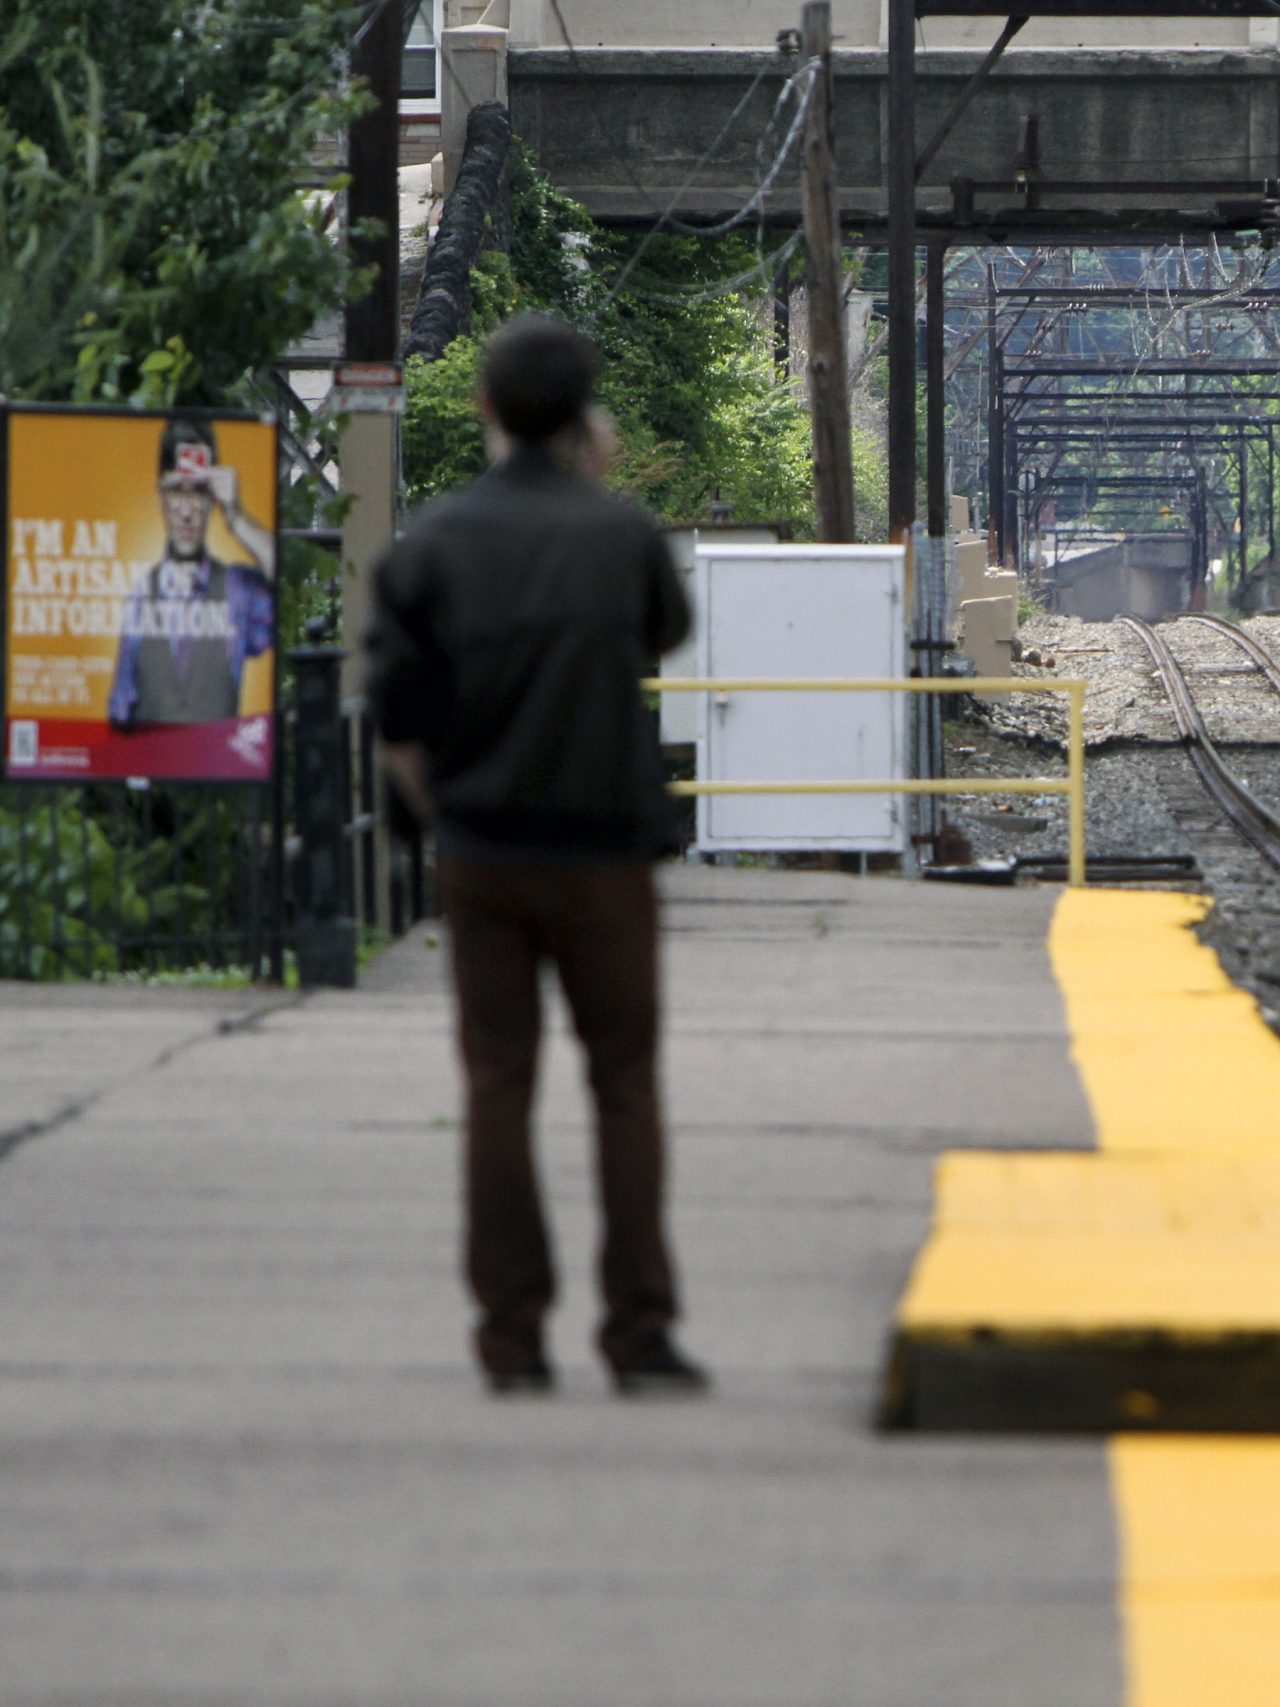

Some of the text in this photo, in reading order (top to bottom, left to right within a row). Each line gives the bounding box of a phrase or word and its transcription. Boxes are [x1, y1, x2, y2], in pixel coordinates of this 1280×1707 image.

[12, 518, 117, 557] I'M AN
[12, 558, 198, 597] ARTISAN OF
